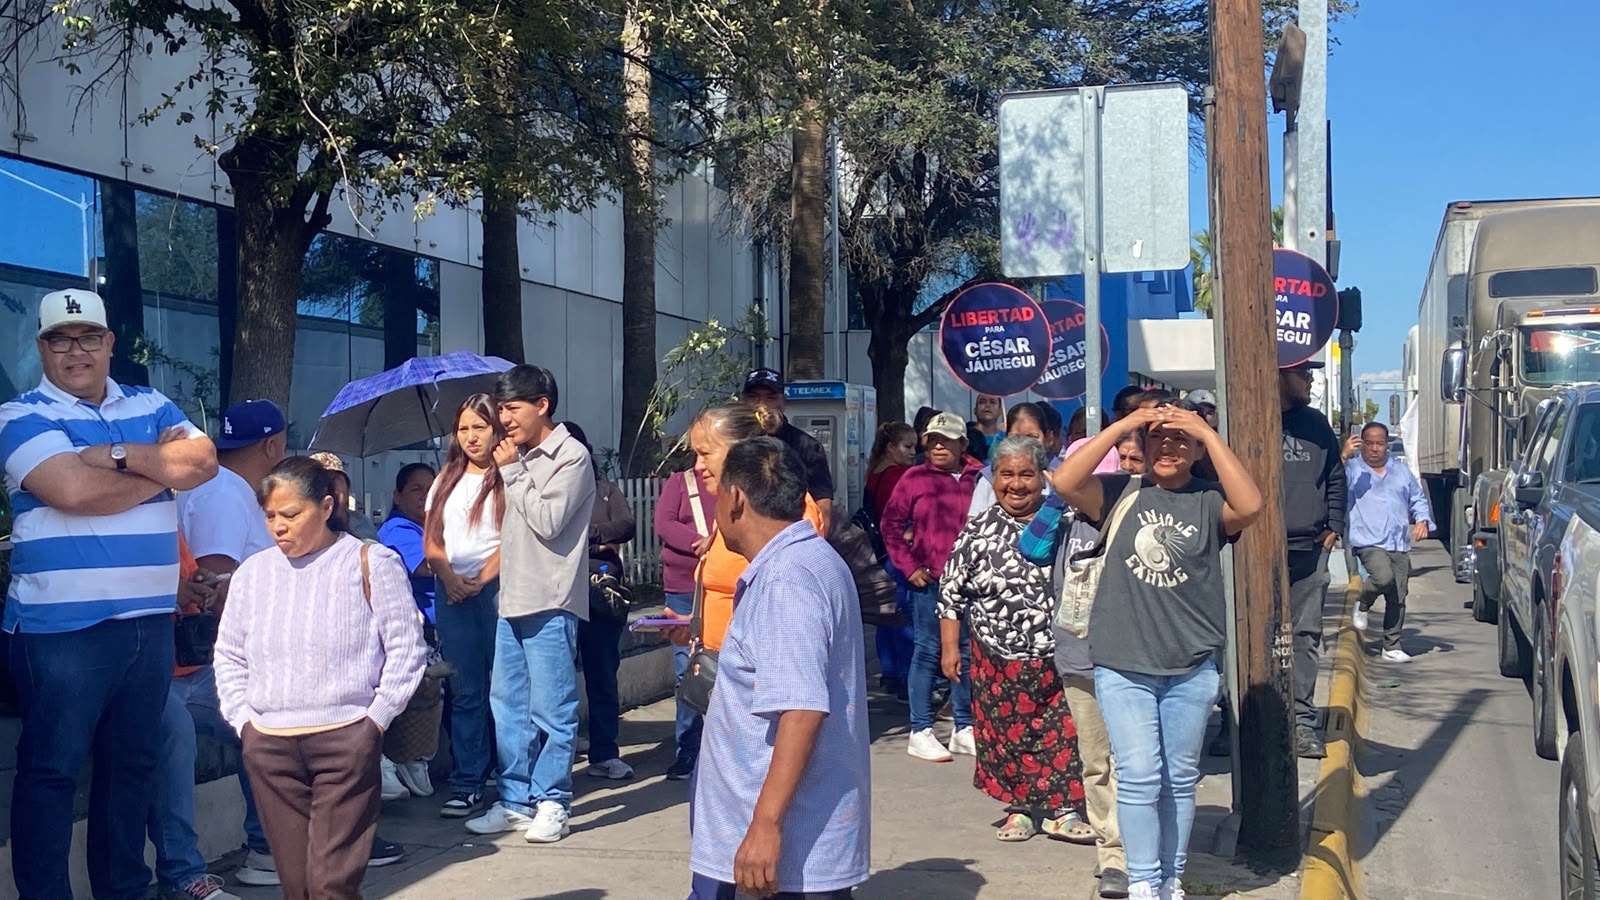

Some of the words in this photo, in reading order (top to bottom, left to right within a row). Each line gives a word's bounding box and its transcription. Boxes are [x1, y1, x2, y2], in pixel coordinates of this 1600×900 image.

[1274, 277, 1328, 298] RTAD
[64, 294, 82, 314] LA
[951, 306, 1035, 328] LIBERTAD
[1049, 312, 1085, 335] RTAD
[965, 336, 1031, 358] CÉSAR
[1276, 328, 1312, 346] EGUI
[965, 354, 1036, 374] JÁUREGUI
[792, 386, 832, 395] TELMEX
